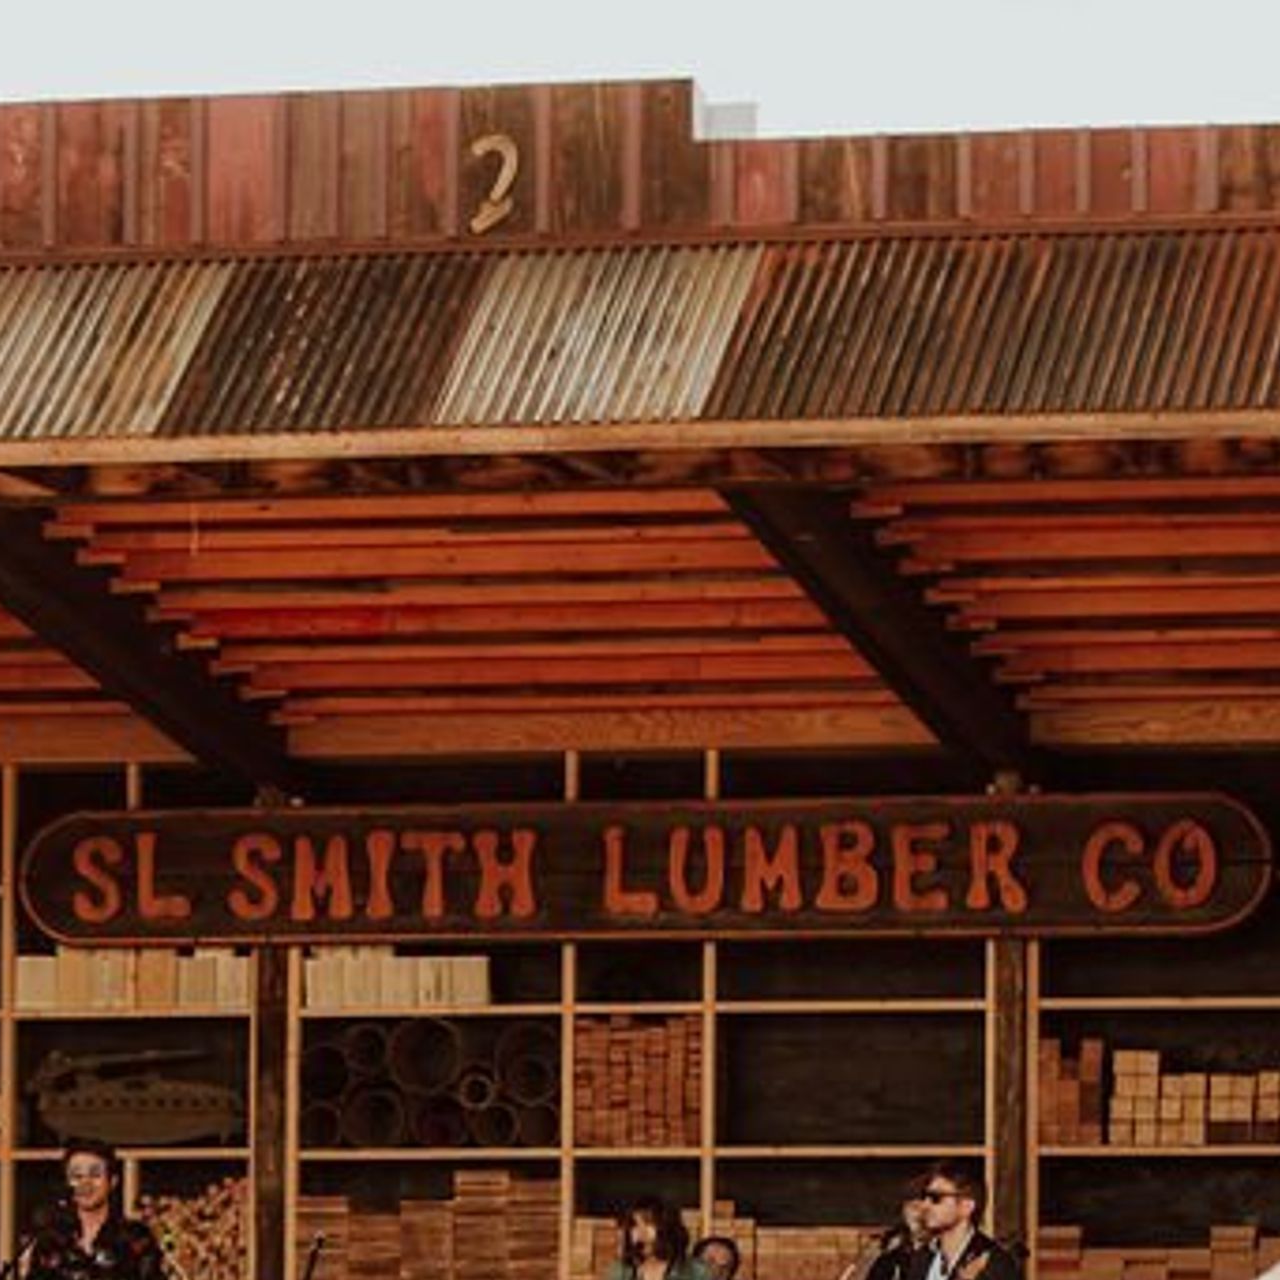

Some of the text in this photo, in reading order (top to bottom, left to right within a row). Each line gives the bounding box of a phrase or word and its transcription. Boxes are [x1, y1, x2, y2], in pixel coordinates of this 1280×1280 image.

[470, 133, 519, 234] 2
[72, 820, 1217, 922] SL SMITH LUMBER CO
